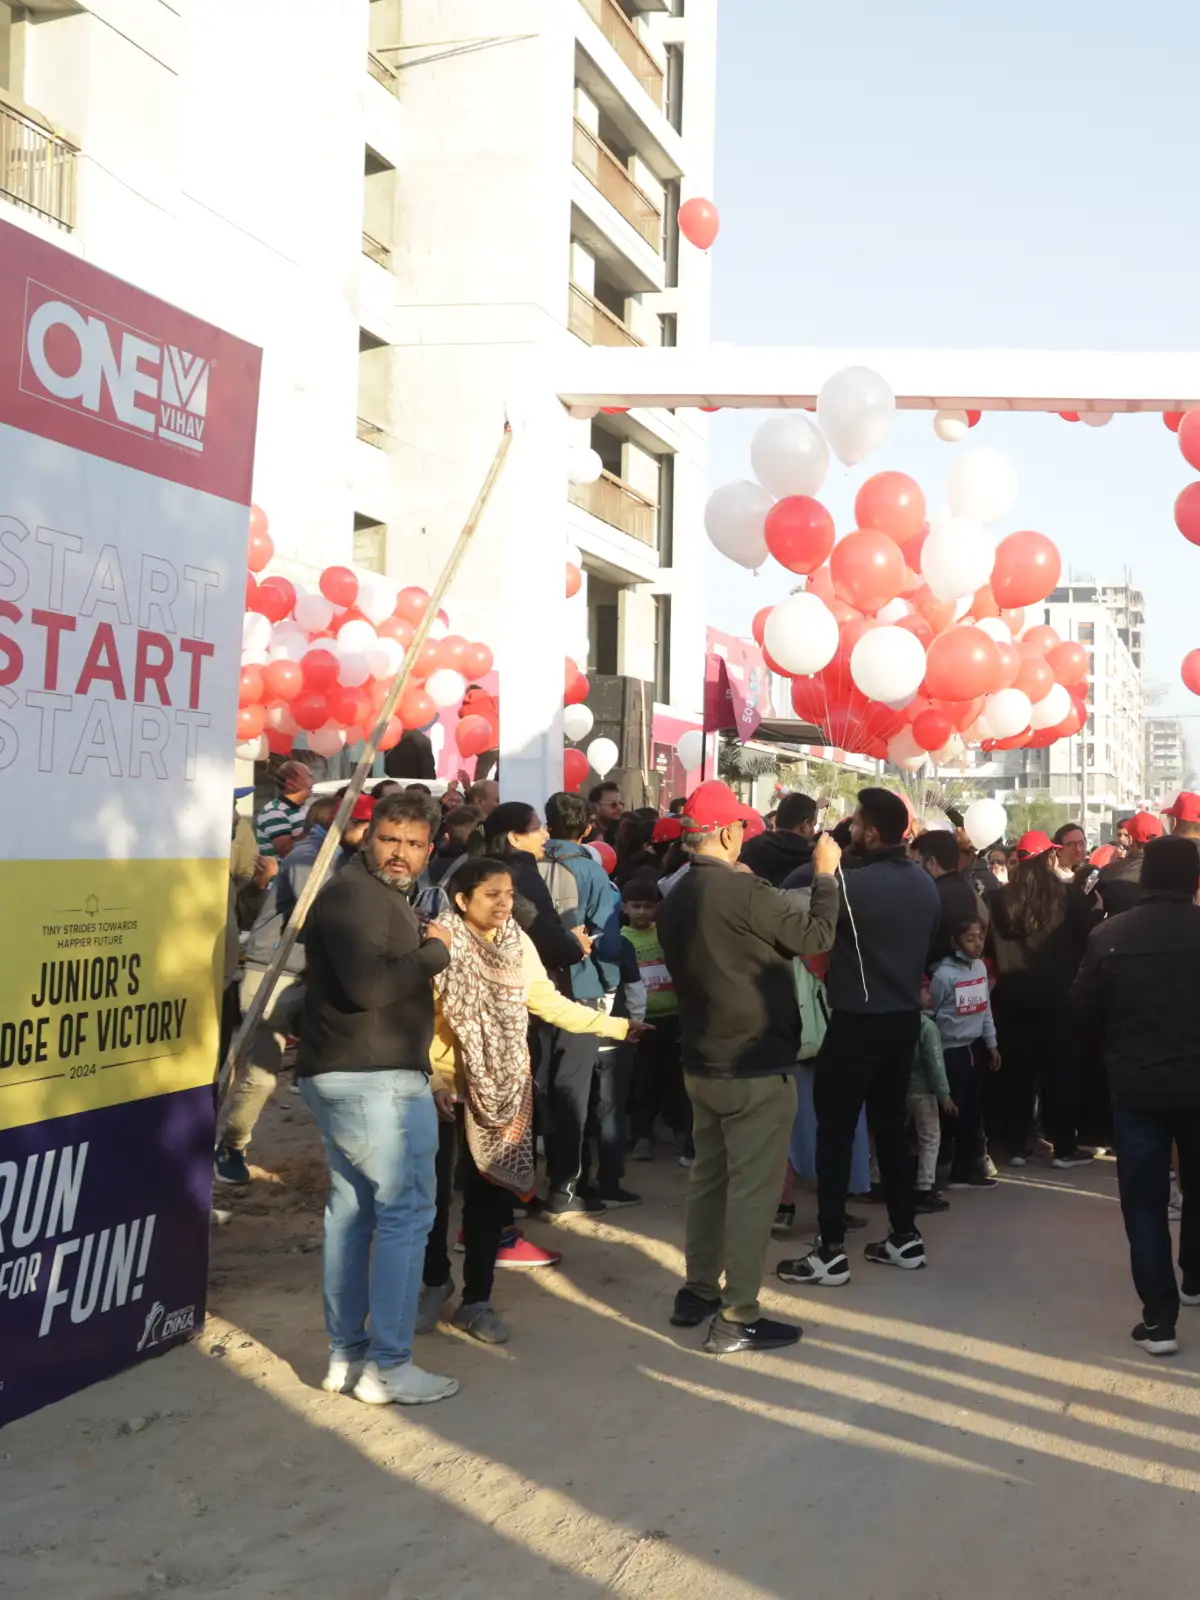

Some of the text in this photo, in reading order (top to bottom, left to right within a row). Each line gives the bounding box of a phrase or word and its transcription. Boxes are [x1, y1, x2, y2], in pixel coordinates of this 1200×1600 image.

[27, 300, 161, 434] ONE
[160, 404, 205, 440] VIHAV
[42, 920, 138, 935] TINY STRIDES TOWARDS
[57, 935, 123, 949] HAPPIER FUTURE
[31, 953, 142, 1008] JUNIOR'S
[0, 998, 187, 1069] DGE OF VICTORY
[69, 1064, 97, 1080] 2024
[38, 1214, 157, 1338] FUN!
